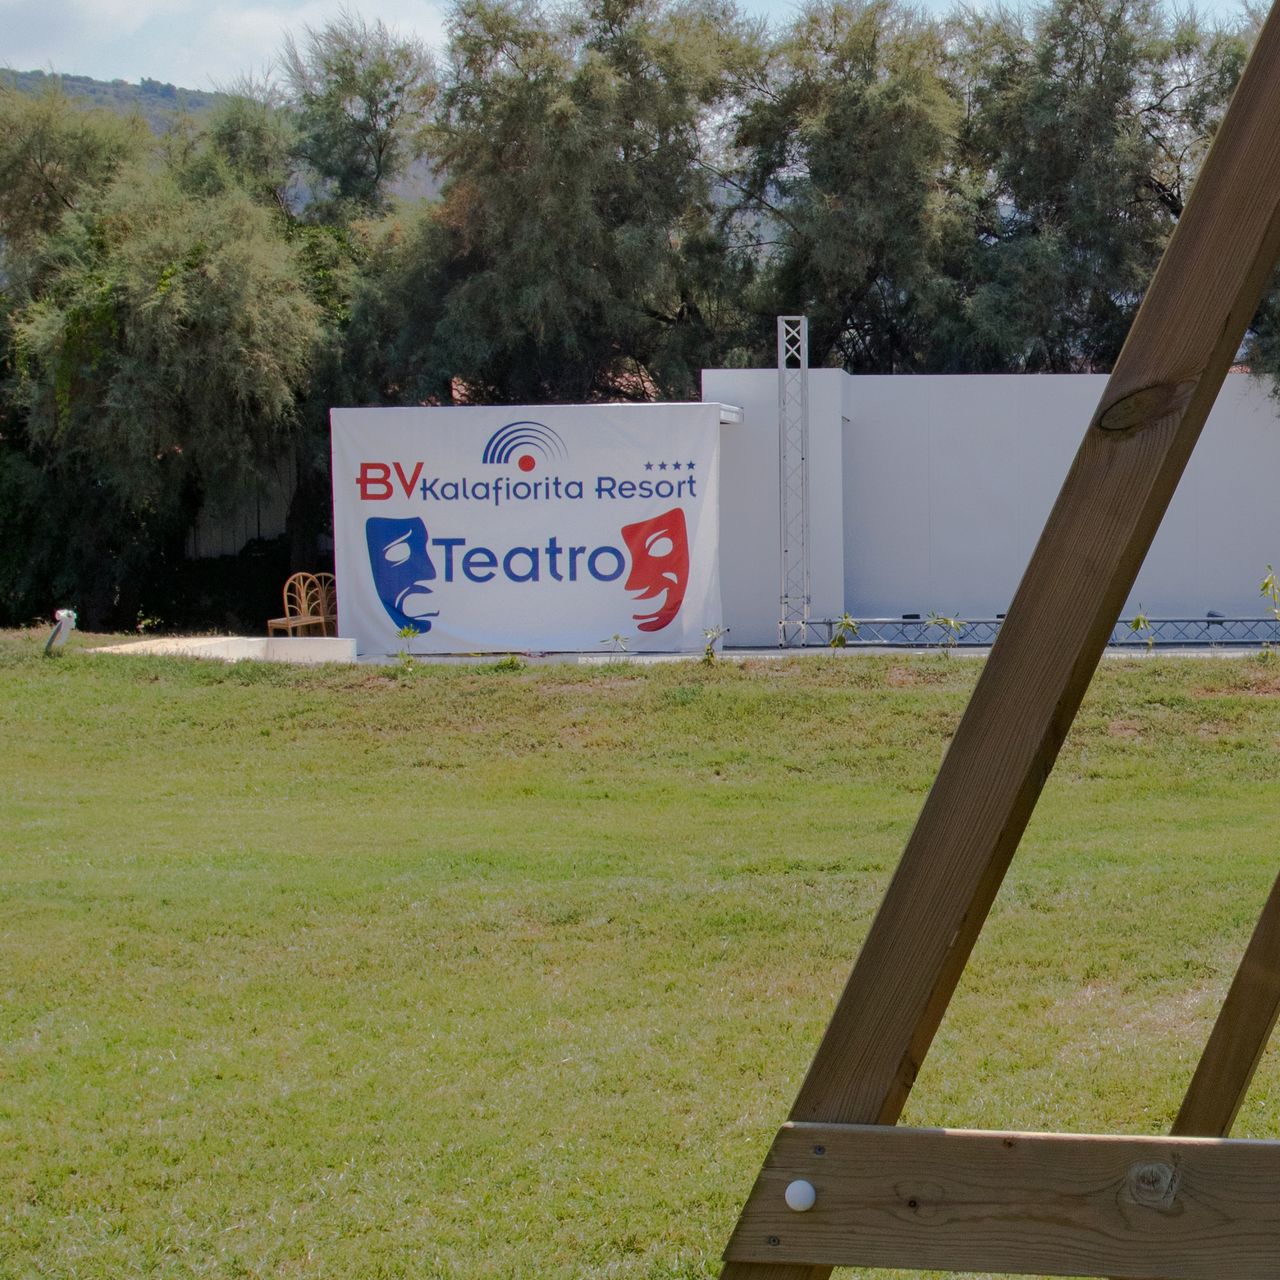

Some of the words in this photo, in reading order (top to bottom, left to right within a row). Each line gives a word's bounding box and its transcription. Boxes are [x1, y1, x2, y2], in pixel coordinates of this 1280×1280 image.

[420, 477, 584, 506] Kalafiorita
[595, 474, 698, 500] Resort
[431, 536, 626, 583] Teatro
